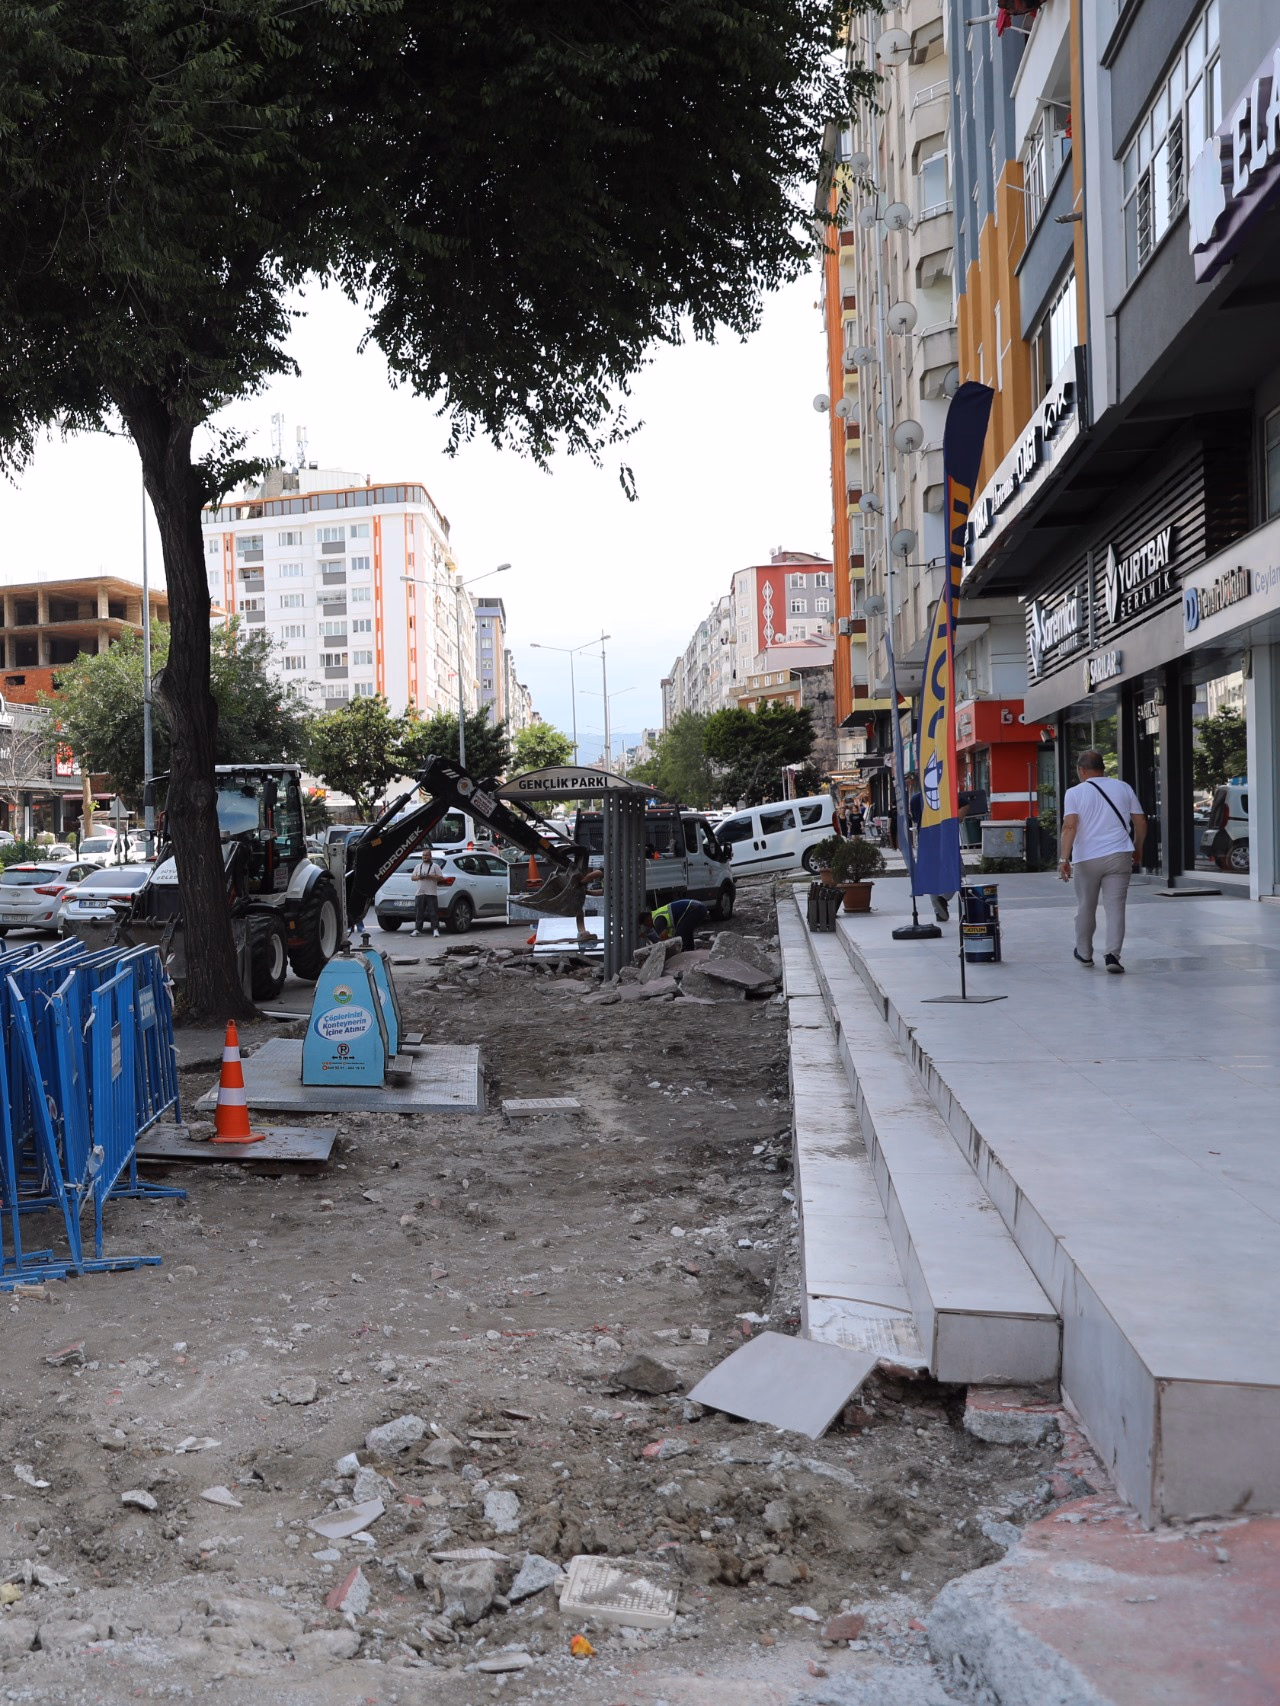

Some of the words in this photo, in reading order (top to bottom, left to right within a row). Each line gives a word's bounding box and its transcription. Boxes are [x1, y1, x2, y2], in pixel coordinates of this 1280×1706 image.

[1119, 525, 1171, 594] YURTBAY
[1090, 650, 1117, 686] SARILAR
[518, 776, 569, 791] GENÇLİK
[571, 776, 608, 788] PARKI
[324, 1010, 363, 1022] Çöplerinizi
[322, 1018, 366, 1030] Konteynerin
[325, 1028, 344, 1037] İçine
